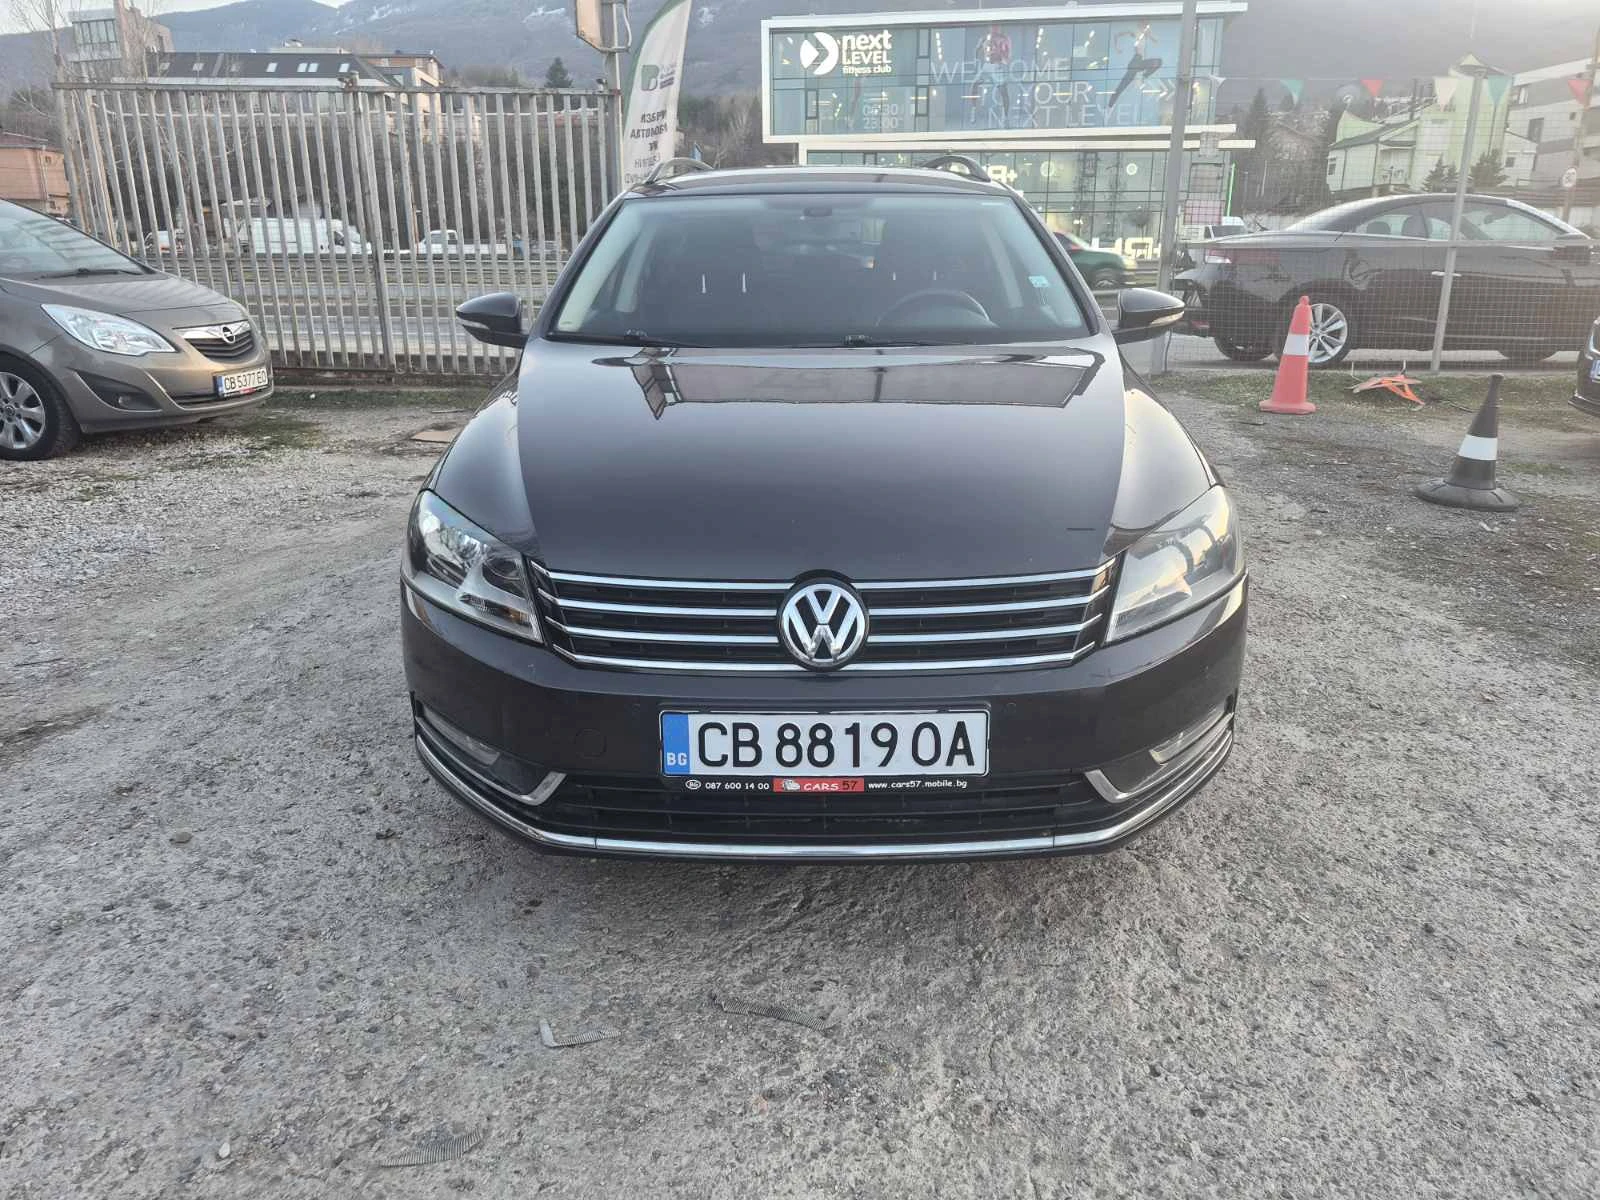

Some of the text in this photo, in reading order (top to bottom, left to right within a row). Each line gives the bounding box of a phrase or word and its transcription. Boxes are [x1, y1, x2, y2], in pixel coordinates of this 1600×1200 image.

[841, 30, 892, 50] next
[841, 50, 892, 64] LEVEL
[842, 64, 892, 74] fitness club
[1018, 81, 1088, 106] YOUR
[988, 106, 1058, 128] NEXT
[237, 372, 256, 388] 5377
[781, 583, 867, 667] VW
[698, 720, 975, 768] CB 8819 OA
[666, 752, 688, 766] BG
[705, 782, 721, 790] 087
[725, 782, 742, 790] 600
[745, 782, 755, 790] 14
[758, 782, 770, 790] 00
[803, 783, 839, 791] CARS
[842, 781, 858, 791] 57
[868, 780, 968, 790] www.cars57.mobile.bg
